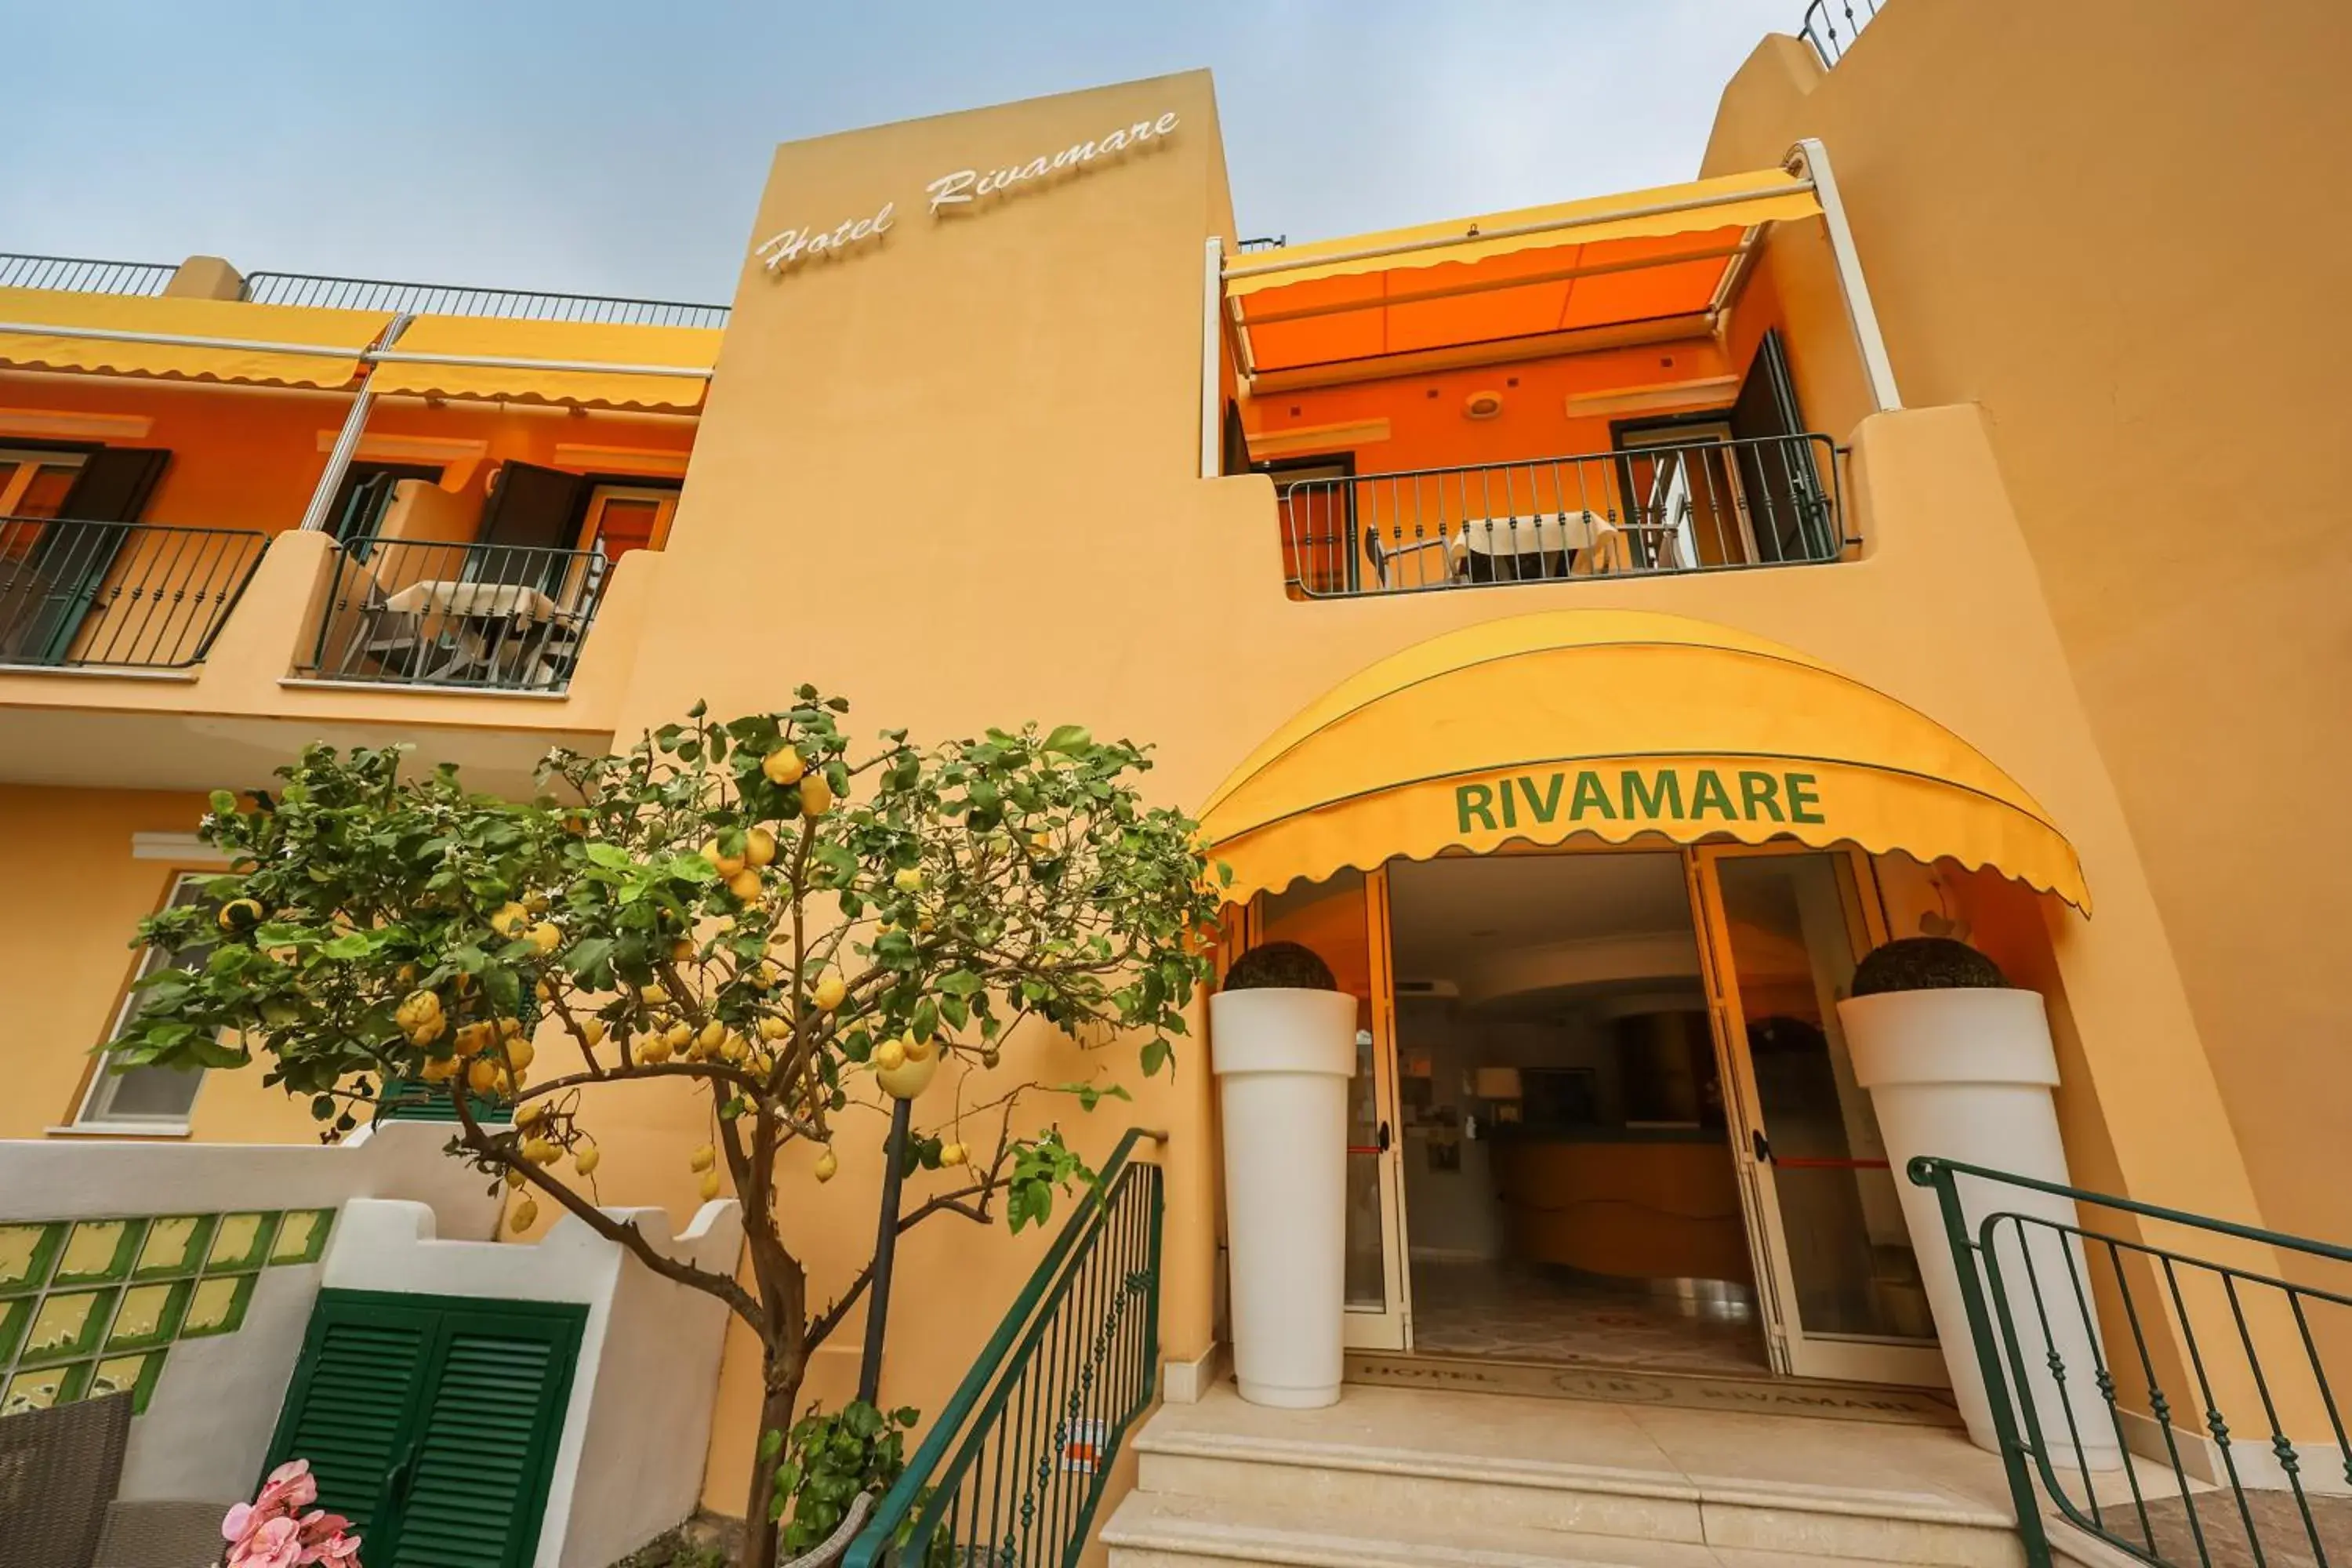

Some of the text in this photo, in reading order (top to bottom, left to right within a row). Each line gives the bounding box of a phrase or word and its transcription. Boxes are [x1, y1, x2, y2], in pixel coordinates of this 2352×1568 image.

[756, 111, 1180, 270] Hotel Rivamare
[1456, 769, 1825, 834] RIVAMARE
